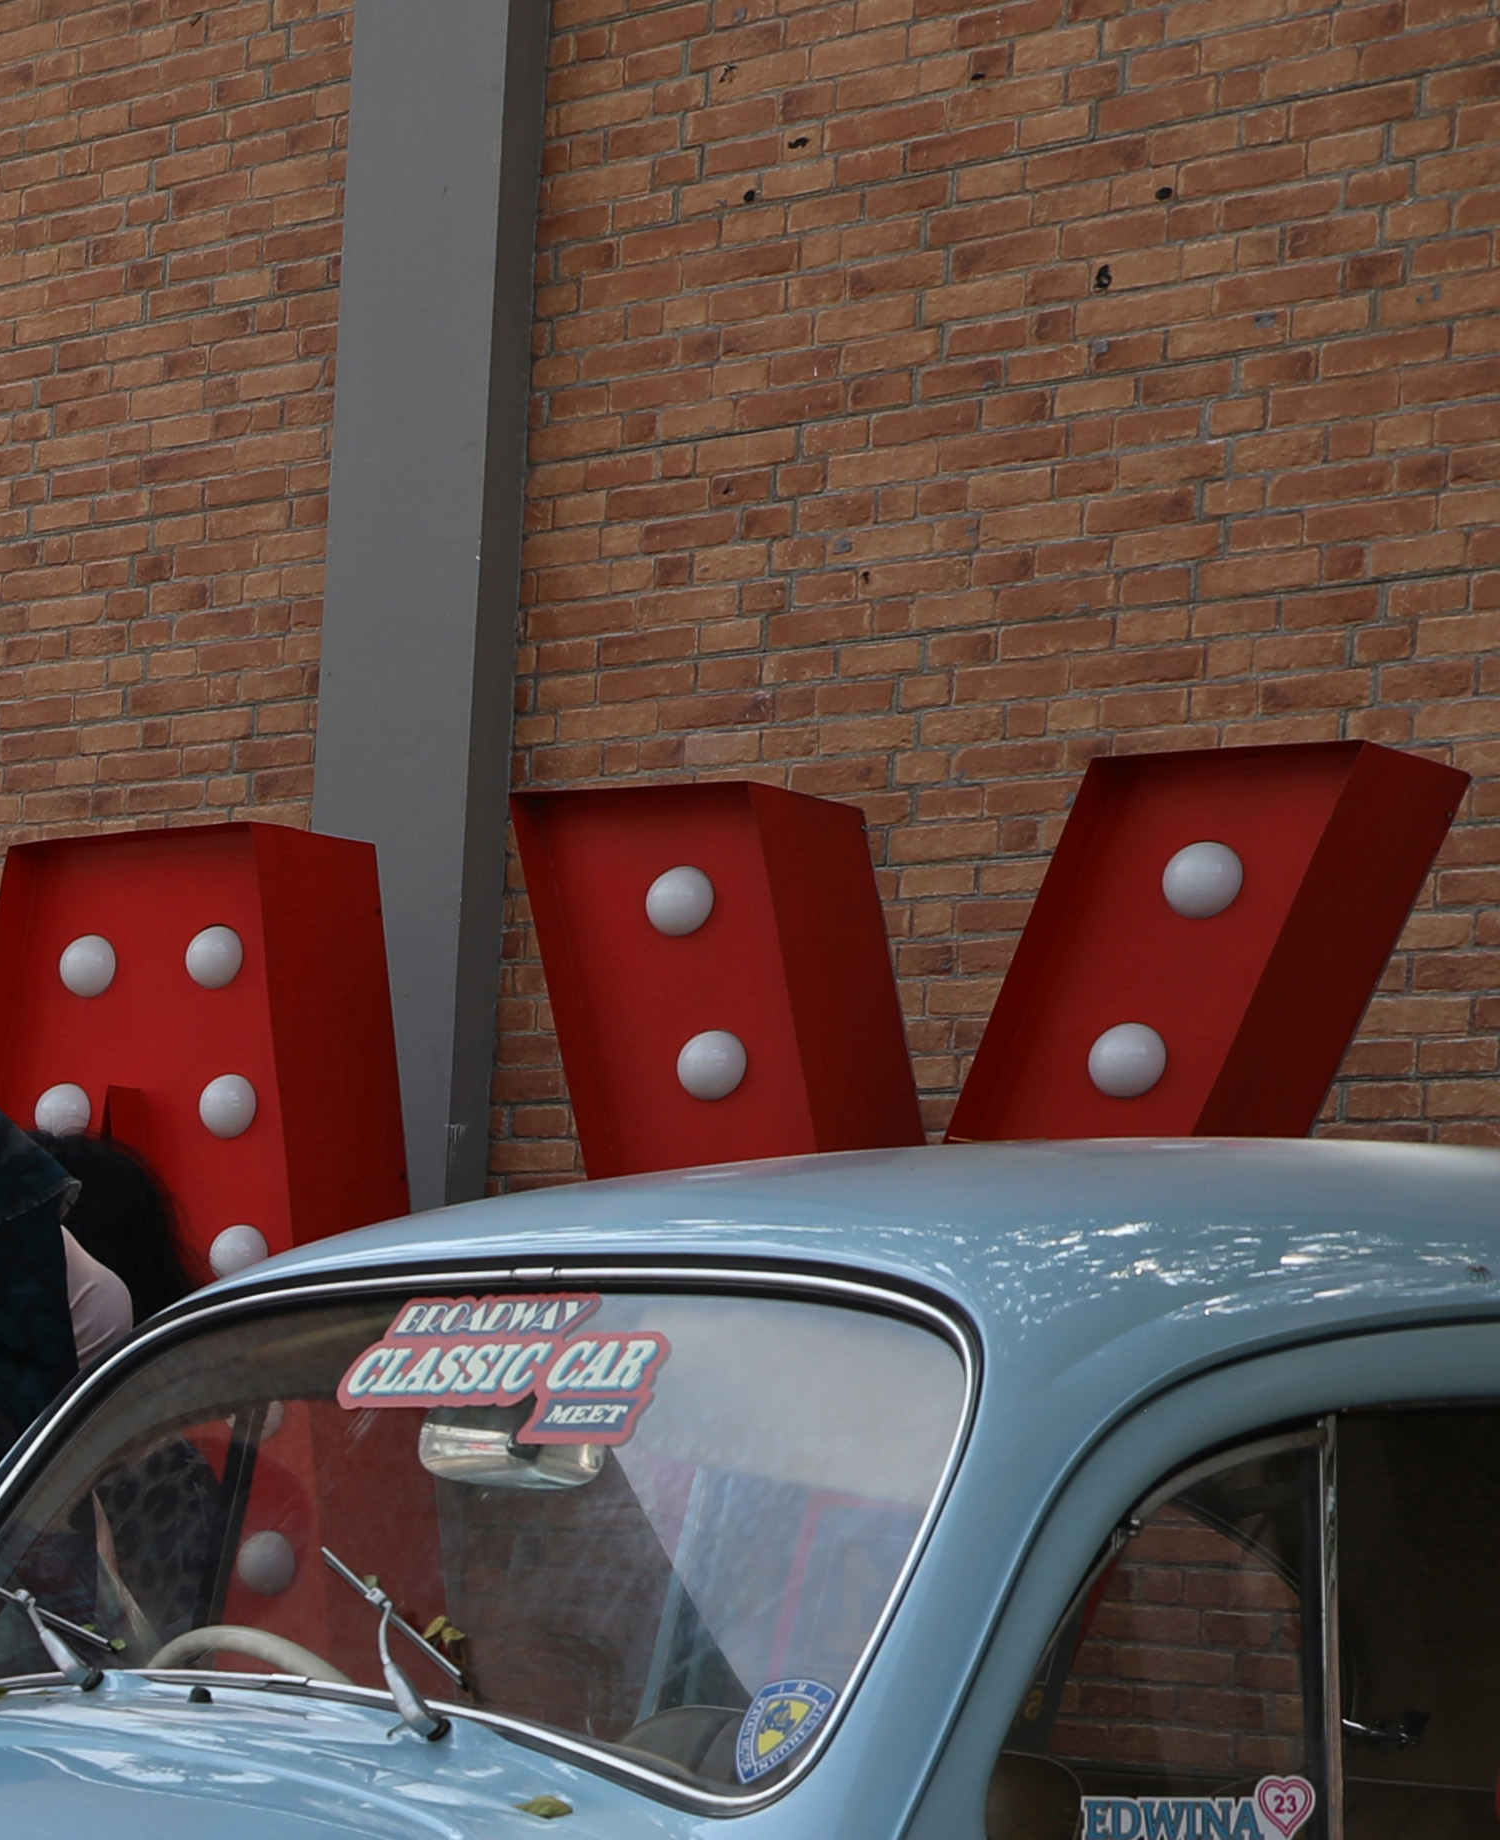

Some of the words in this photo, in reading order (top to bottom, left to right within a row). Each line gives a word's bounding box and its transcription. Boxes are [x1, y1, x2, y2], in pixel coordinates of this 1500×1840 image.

[394, 1300, 592, 1335] BROADWAY
[347, 1341, 554, 1396] CLASSIC
[546, 1340, 656, 1391] CAR
[544, 1404, 628, 1424] MEET
[1273, 1795, 1298, 1814] 23
